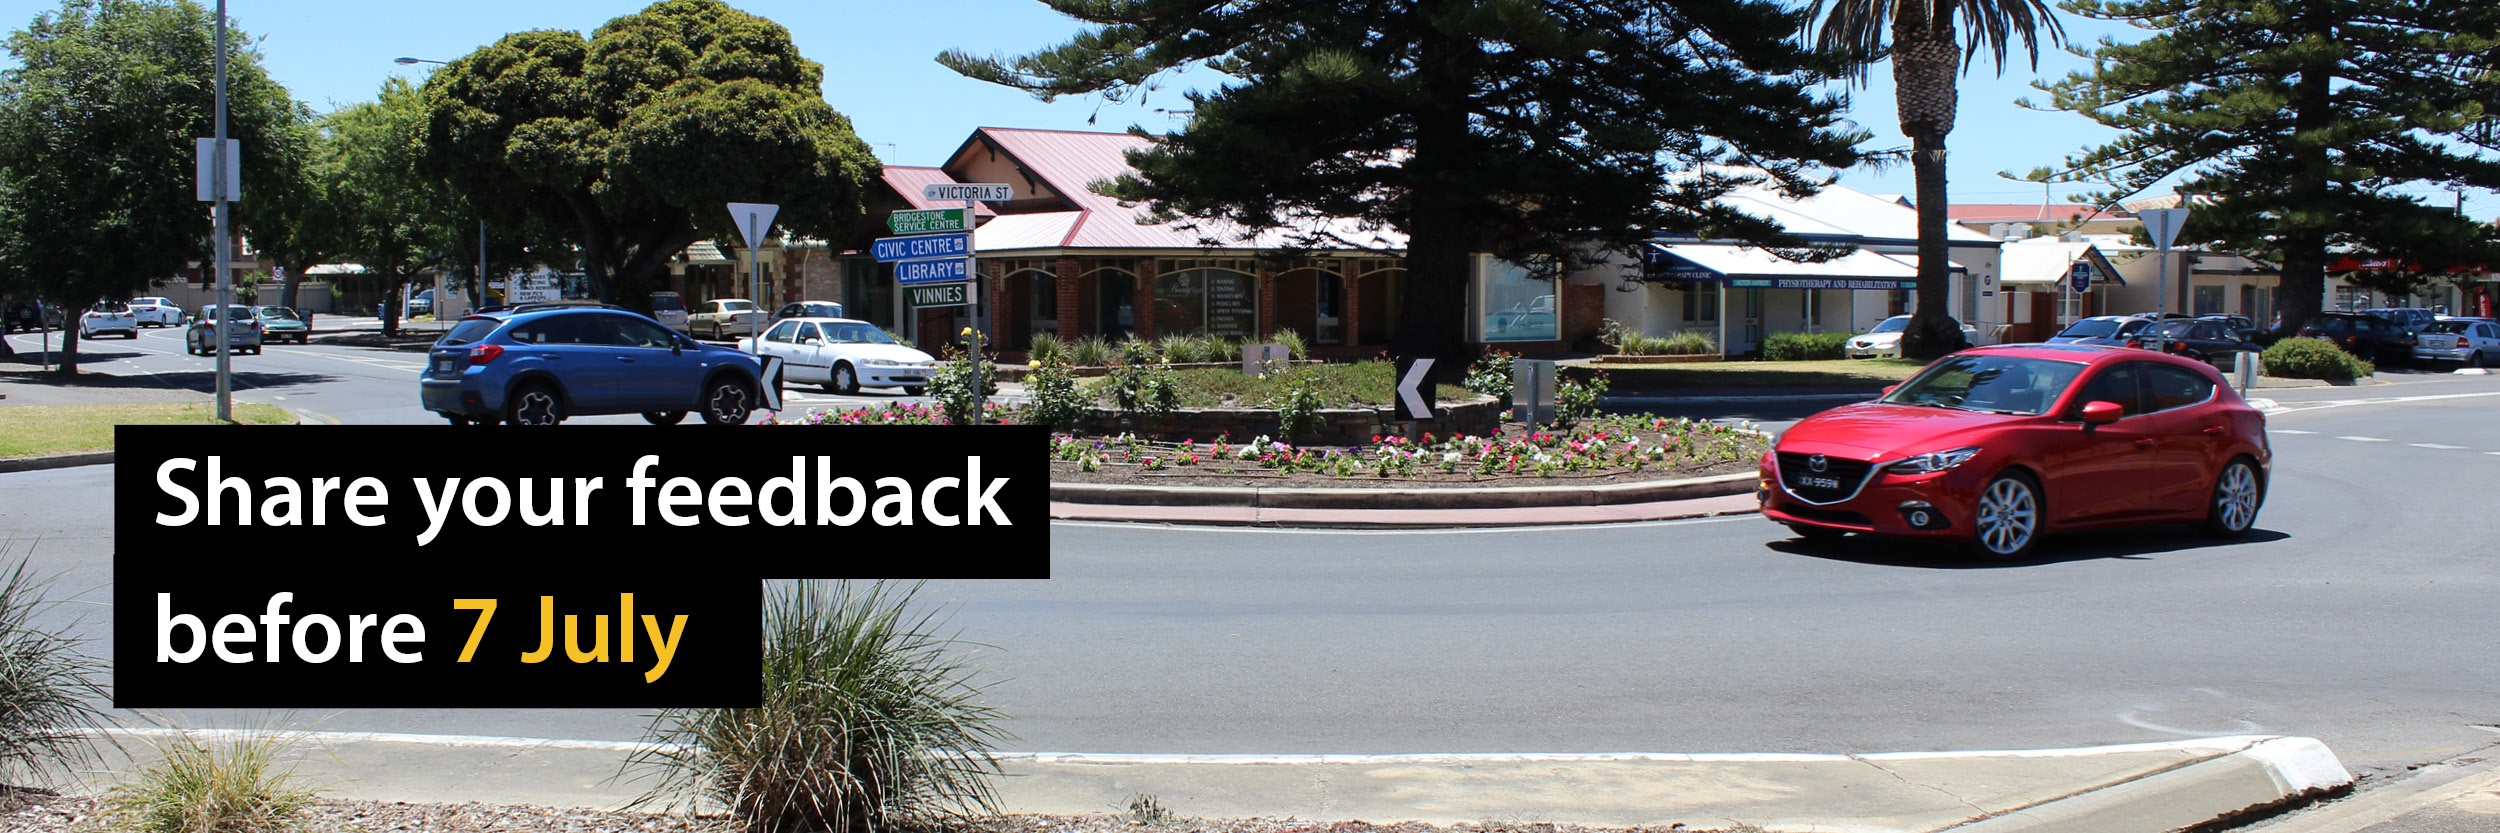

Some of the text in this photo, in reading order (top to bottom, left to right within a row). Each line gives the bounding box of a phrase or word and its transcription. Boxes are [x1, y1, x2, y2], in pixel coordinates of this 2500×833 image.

[939, 186, 1009, 199] VICTORIA ST
[893, 211, 946, 222] BRIDGESTONE
[894, 219, 960, 232] SERVICE CENTRE
[877, 238, 953, 259] CIVIC CENTRE
[899, 262, 954, 281] LIBRARY
[1778, 279, 1832, 288] PHYSIOTHERAPY
[1832, 280, 1846, 288] AND
[1847, 280, 1897, 289] REHABILITATION
[913, 286, 962, 304] VINNIES
